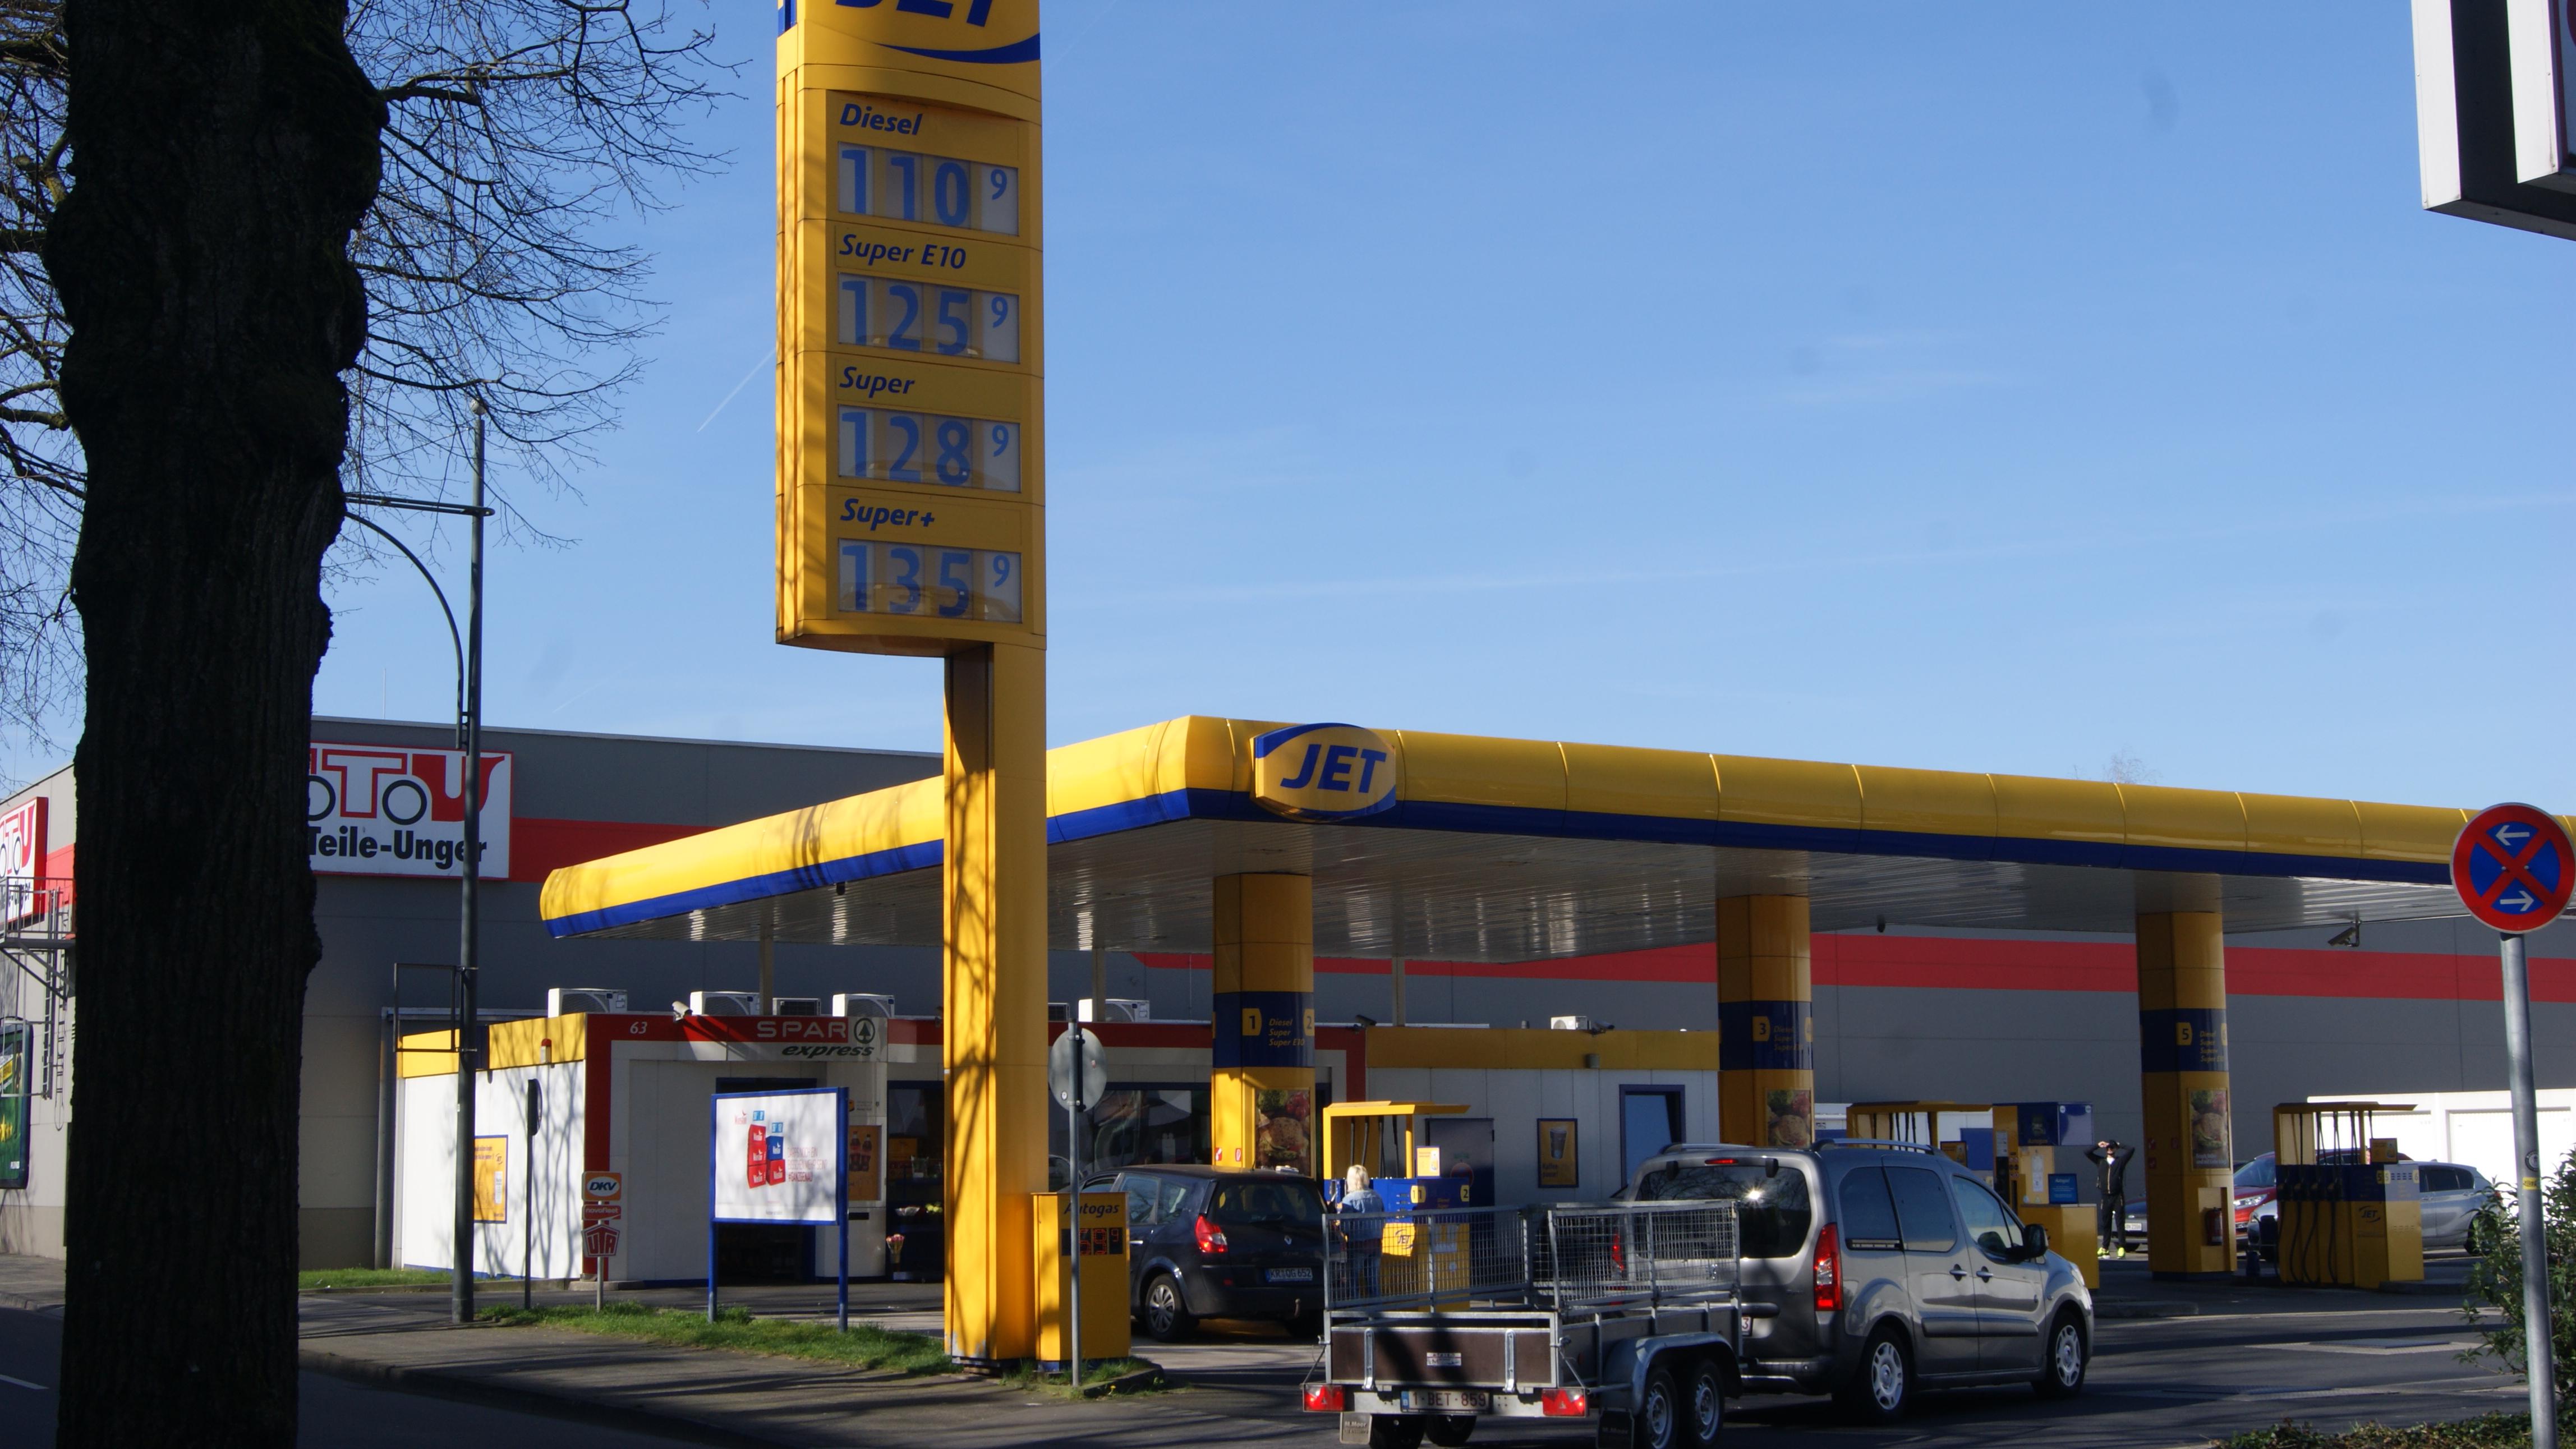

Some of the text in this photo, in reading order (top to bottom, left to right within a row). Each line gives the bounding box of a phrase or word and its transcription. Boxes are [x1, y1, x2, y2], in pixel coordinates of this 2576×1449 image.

[839, 103, 923, 136] Diesel
[839, 233, 967, 269] Super E10
[839, 366, 915, 398] Super
[840, 498, 935, 531] Super+
[1280, 743, 1387, 793] JET
[629, 1021, 647, 1034] 63
[1249, 1015, 1255, 1029] 1
[1268, 1018, 1292, 1027] Diesel
[1306, 1015, 1313, 1029] 2
[757, 1020, 847, 1038] SPAR
[1268, 1028, 1291, 1037] Super
[1759, 1023, 1766, 1035] 3
[2182, 1028, 2189, 1040] 5
[1268, 1038, 1291, 1047] Super
[781, 1045, 875, 1059] express
[589, 1181, 617, 1191] DKV
[1463, 1189, 1469, 1198] 2
[2361, 1209, 2378, 1218] JET
[586, 1226, 618, 1254] UTA
[1297, 1268, 1312, 1277] 652
